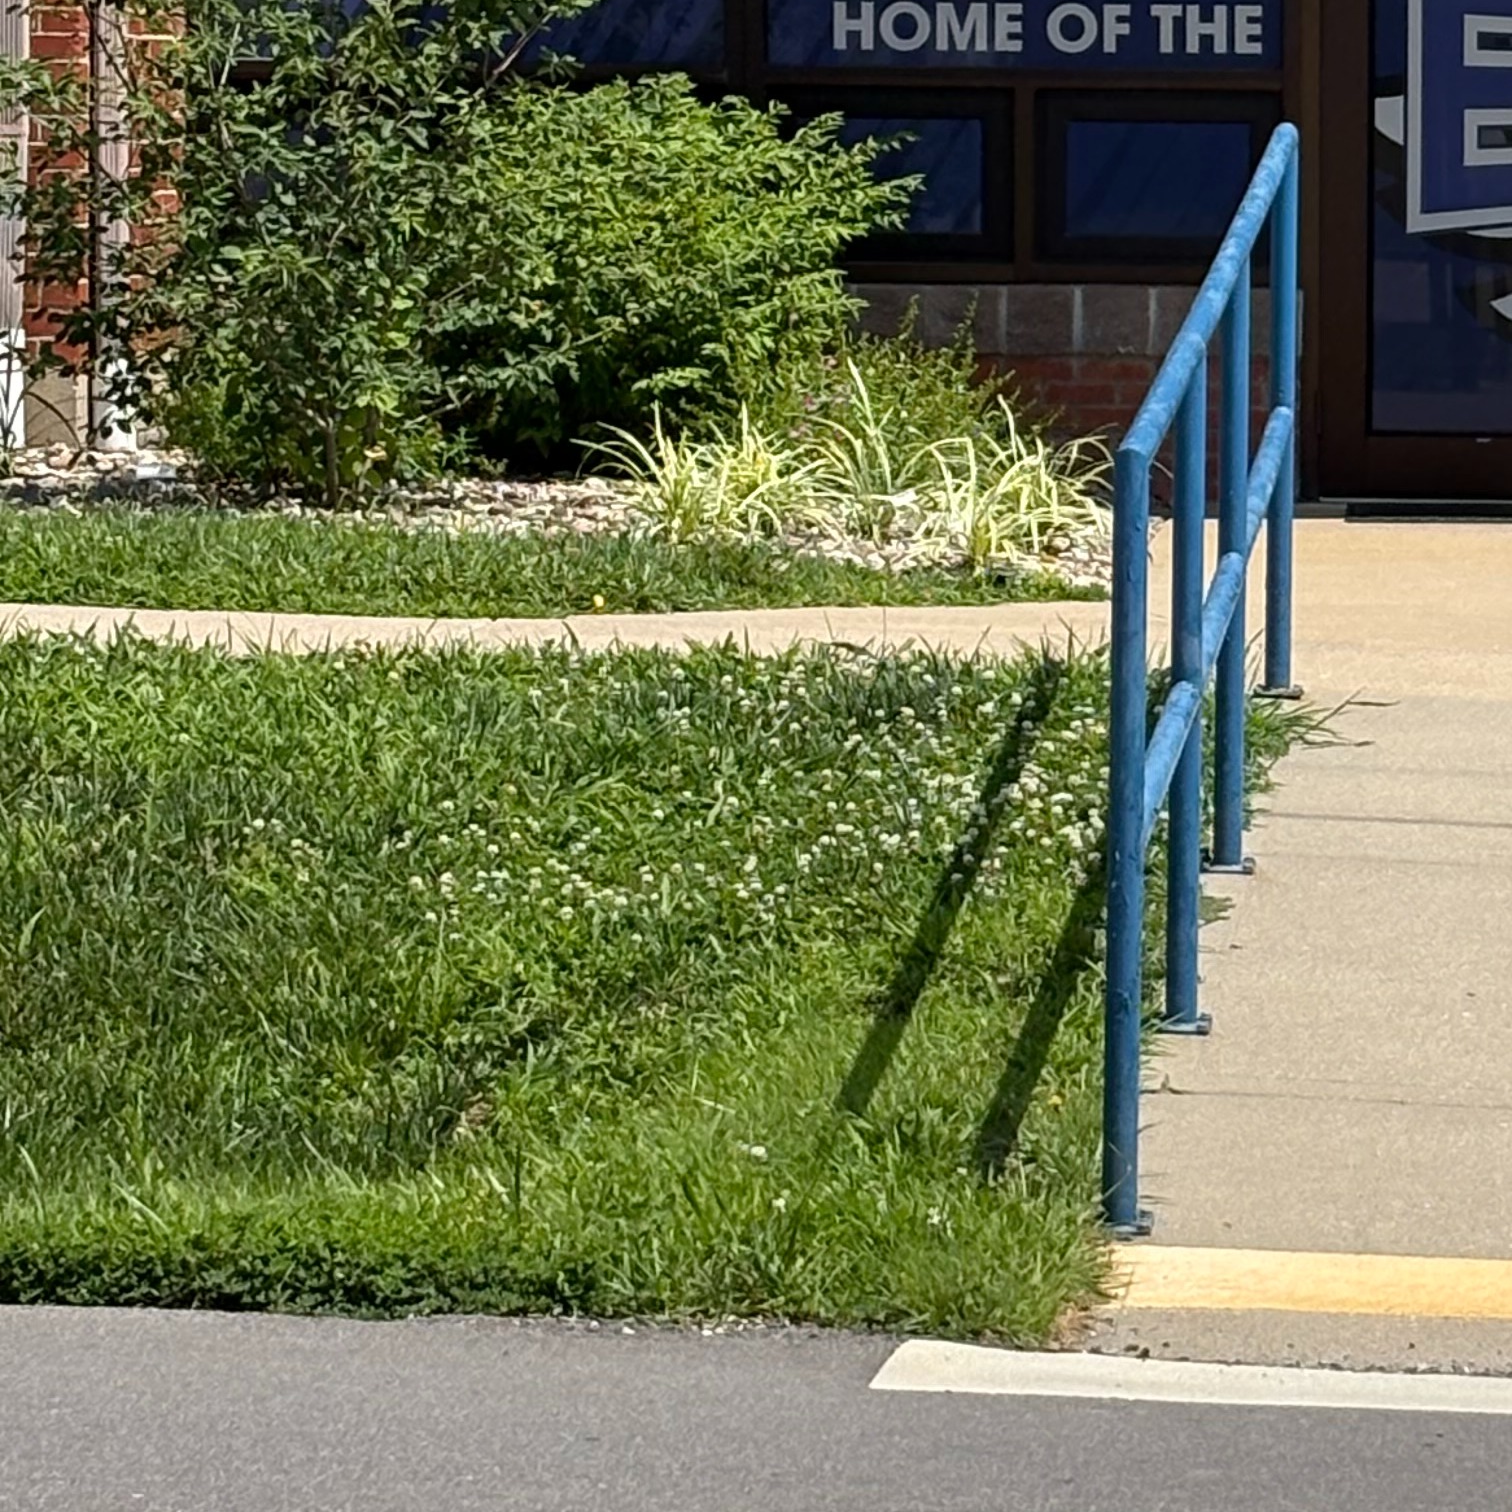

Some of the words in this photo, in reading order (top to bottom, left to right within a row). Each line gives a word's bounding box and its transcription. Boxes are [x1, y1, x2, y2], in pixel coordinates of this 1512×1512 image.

[832, 1, 1024, 53] HOME
[1046, 2, 1131, 54] OF
[1150, 4, 1264, 55] THE
